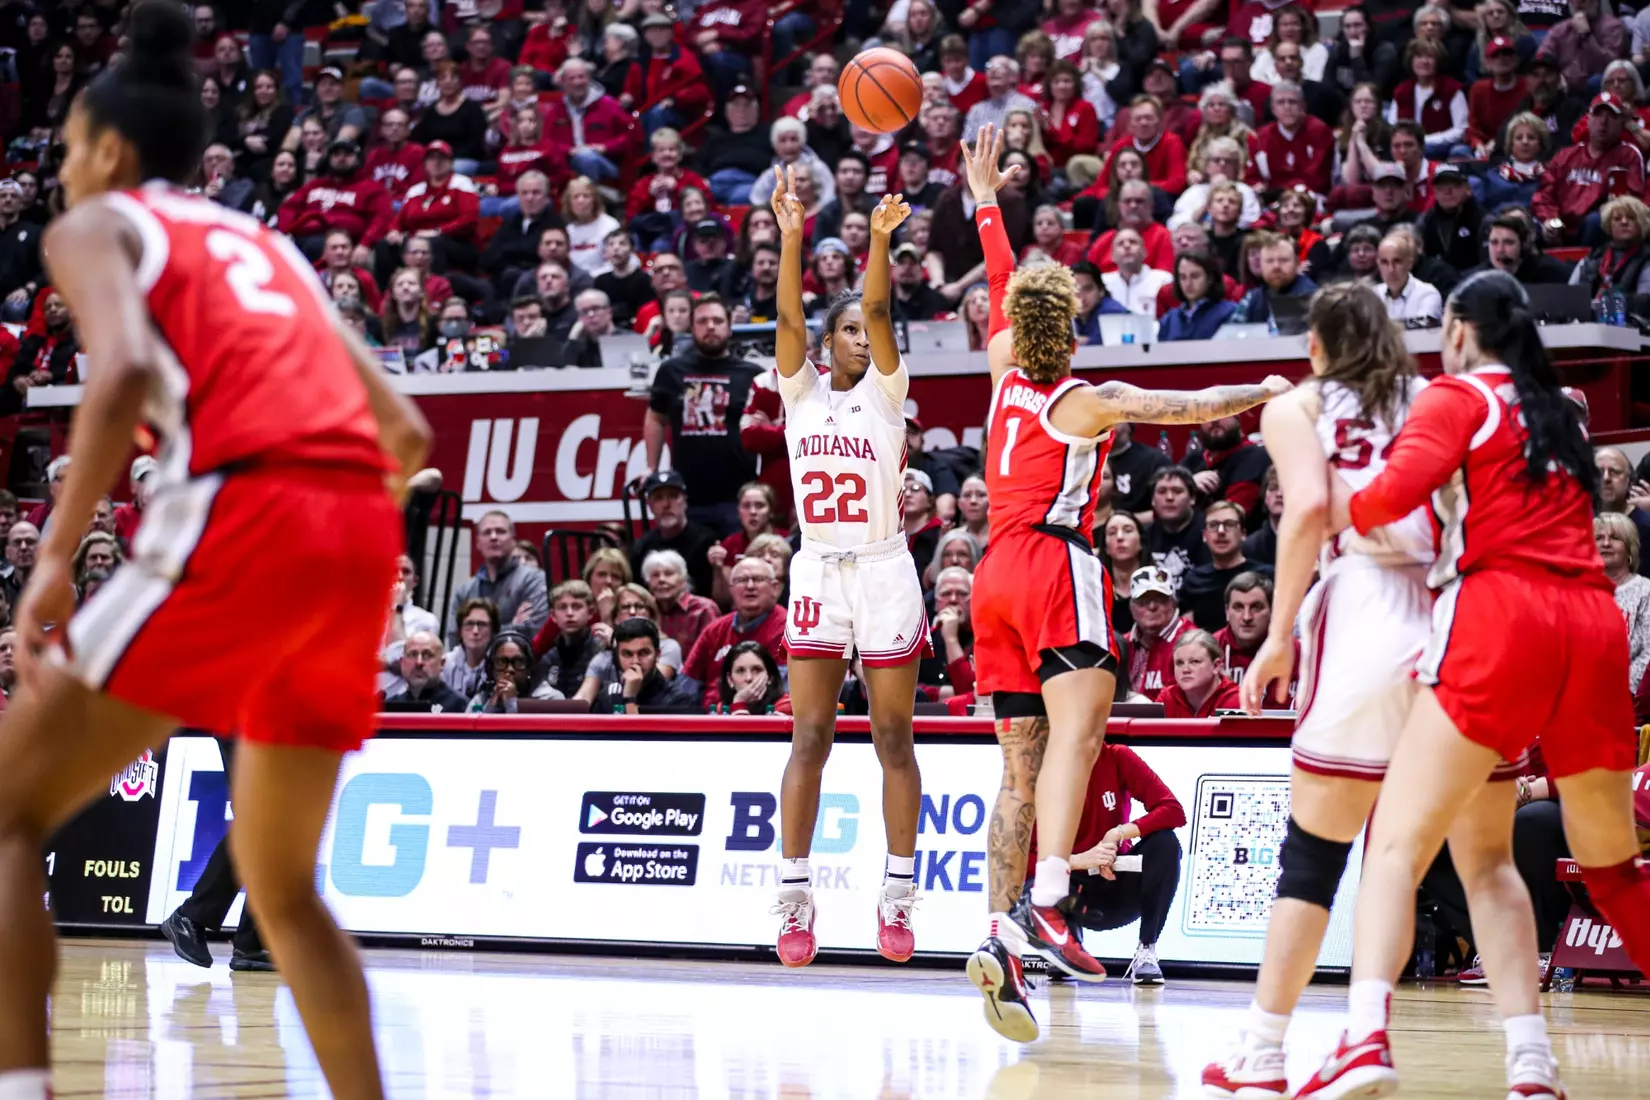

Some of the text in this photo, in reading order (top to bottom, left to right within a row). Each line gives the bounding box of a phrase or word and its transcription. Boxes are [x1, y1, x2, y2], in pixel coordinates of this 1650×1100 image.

[206, 229, 297, 317] 2
[795, 435, 877, 462] INDIANA
[1000, 417, 1022, 476] 1
[462, 417, 539, 503] IU
[801, 471, 868, 524] 22
[611, 807, 699, 831] Google Play
[614, 847, 689, 860] Download on the
[84, 860, 141, 878] FOULS
[611, 860, 688, 882] App Store
[101, 896, 134, 914] TOL
